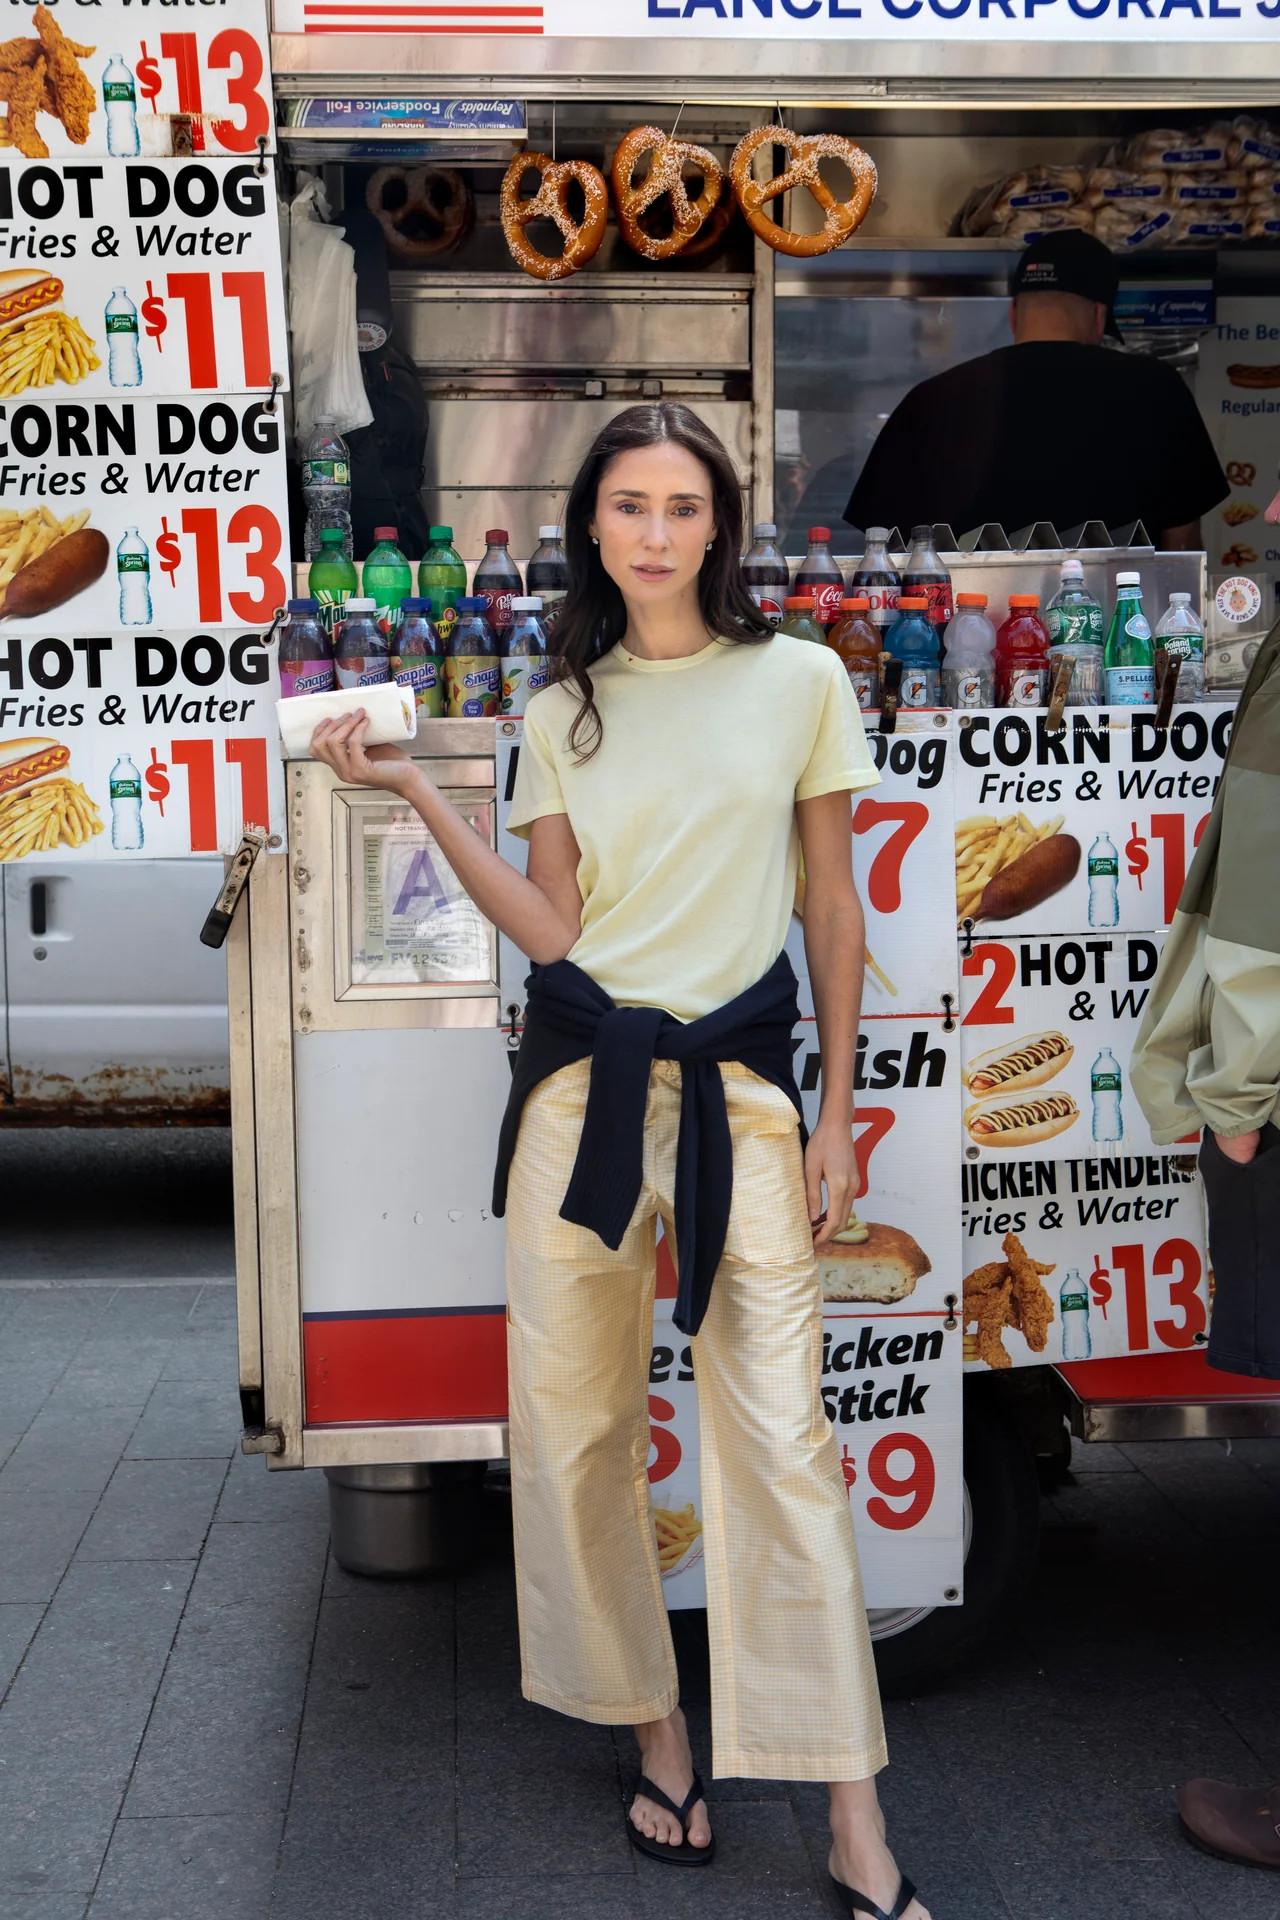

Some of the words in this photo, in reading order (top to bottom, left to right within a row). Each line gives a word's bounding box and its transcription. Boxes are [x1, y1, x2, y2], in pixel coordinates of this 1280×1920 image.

[135, 28, 270, 153] $13
[326, 101, 351, 113] Foil
[357, 101, 440, 114] Foodservice
[460, 101, 513, 116] Reynolds
[126, 165, 266, 219] DOG
[91, 225, 120, 258] &
[135, 225, 252, 257] Water
[141, 272, 272, 389] $11
[1216, 324, 1249, 341] The
[0, 403, 136, 458] ORN
[156, 402, 280, 455] DOG
[0, 463, 87, 496] Fries
[100, 463, 129, 495] &
[145, 462, 260, 494] Water
[156, 504, 287, 625] $13
[134, 634, 269, 687] DOG
[464, 664, 500, 686] Snapp
[296, 668, 333, 691] Snapp
[901, 675, 926, 706] G
[957, 676, 981, 704] G
[1013, 675, 1040, 706] G
[0, 695, 84, 728] Fries
[98, 694, 127, 726] &
[142, 694, 256, 725] Water
[959, 713, 1110, 768] CORN
[145, 738, 270, 852] $11
[978, 771, 1063, 804] Fries
[1075, 770, 1103, 802] &
[392, 849, 452, 915] A
[1125, 811, 1213, 925] $1
[961, 943, 1016, 1025] 2
[1020, 941, 1113, 987] HOT
[1068, 991, 1096, 1021] &
[1038, 1201, 1064, 1230] &
[1078, 1196, 1179, 1227] Water
[1089, 1237, 1207, 1351] $13
[823, 1326, 944, 1374] icken
[820, 1373, 931, 1424] Stick
